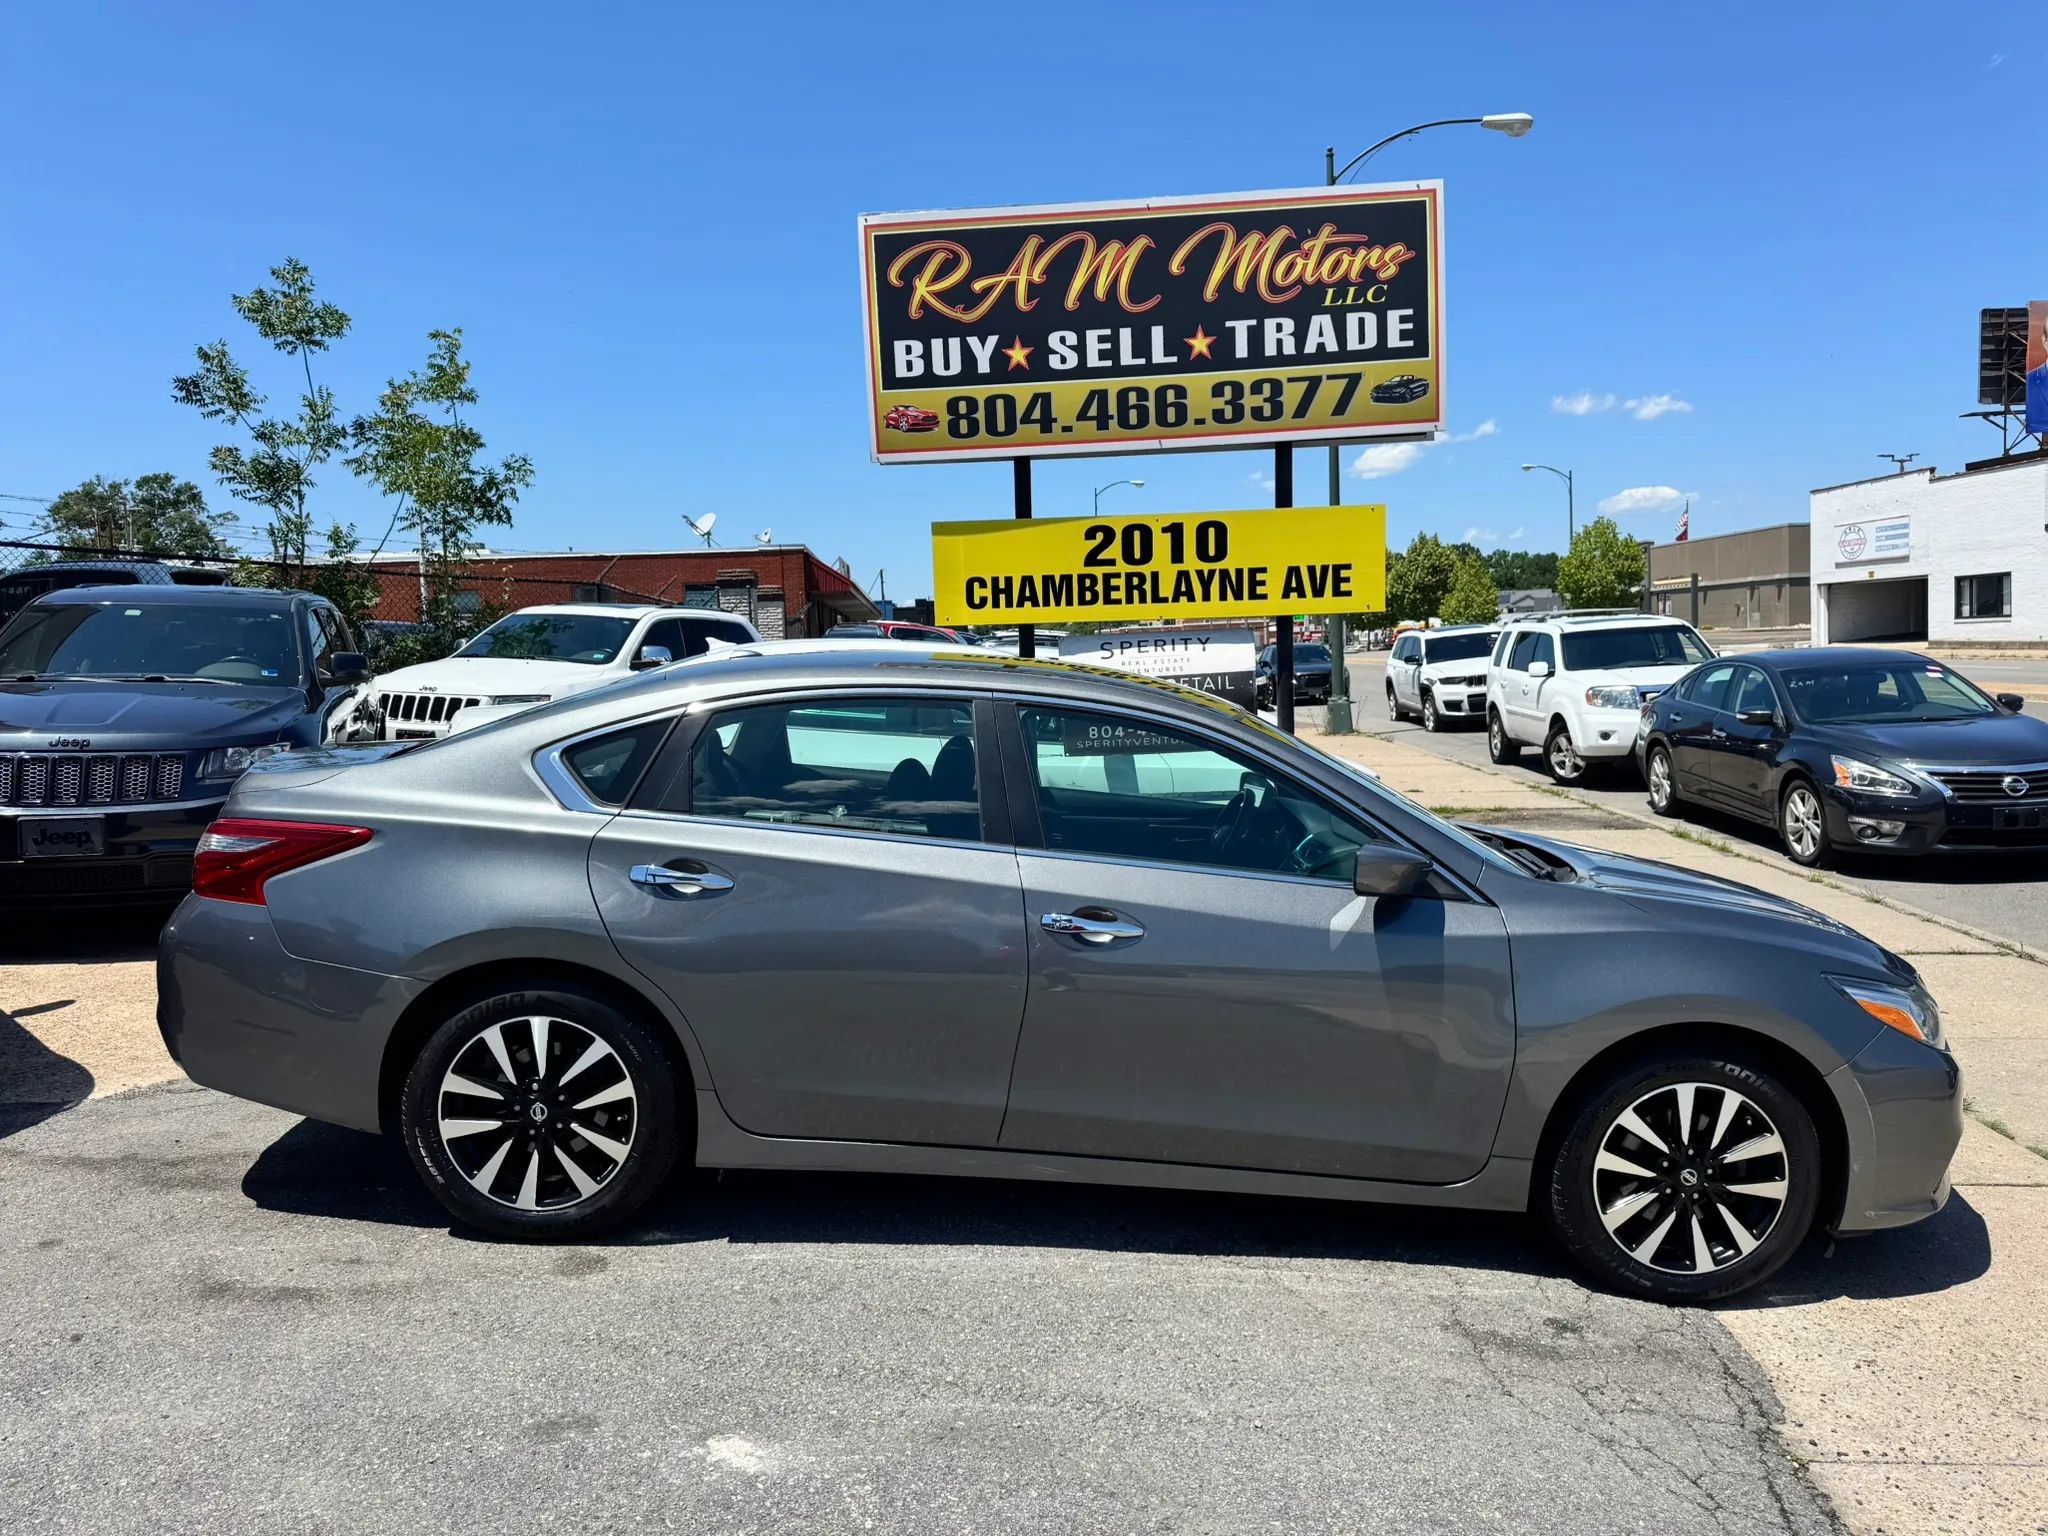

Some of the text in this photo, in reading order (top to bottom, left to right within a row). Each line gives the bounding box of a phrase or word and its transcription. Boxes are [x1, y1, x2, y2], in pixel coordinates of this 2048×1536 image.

[887, 221, 1416, 323] RAM Motors
[1322, 284, 1388, 307] LLC
[893, 308, 1415, 379] BUY SELL TRADE
[946, 372, 1365, 440] 804.466.3377
[1083, 520, 1229, 567] 2010
[965, 564, 1353, 610] CHAMBERLAYNE AVE
[1100, 637, 1211, 660] SPERITY
[48, 735, 90, 749] Jeep
[31, 829, 94, 848] Jeep
